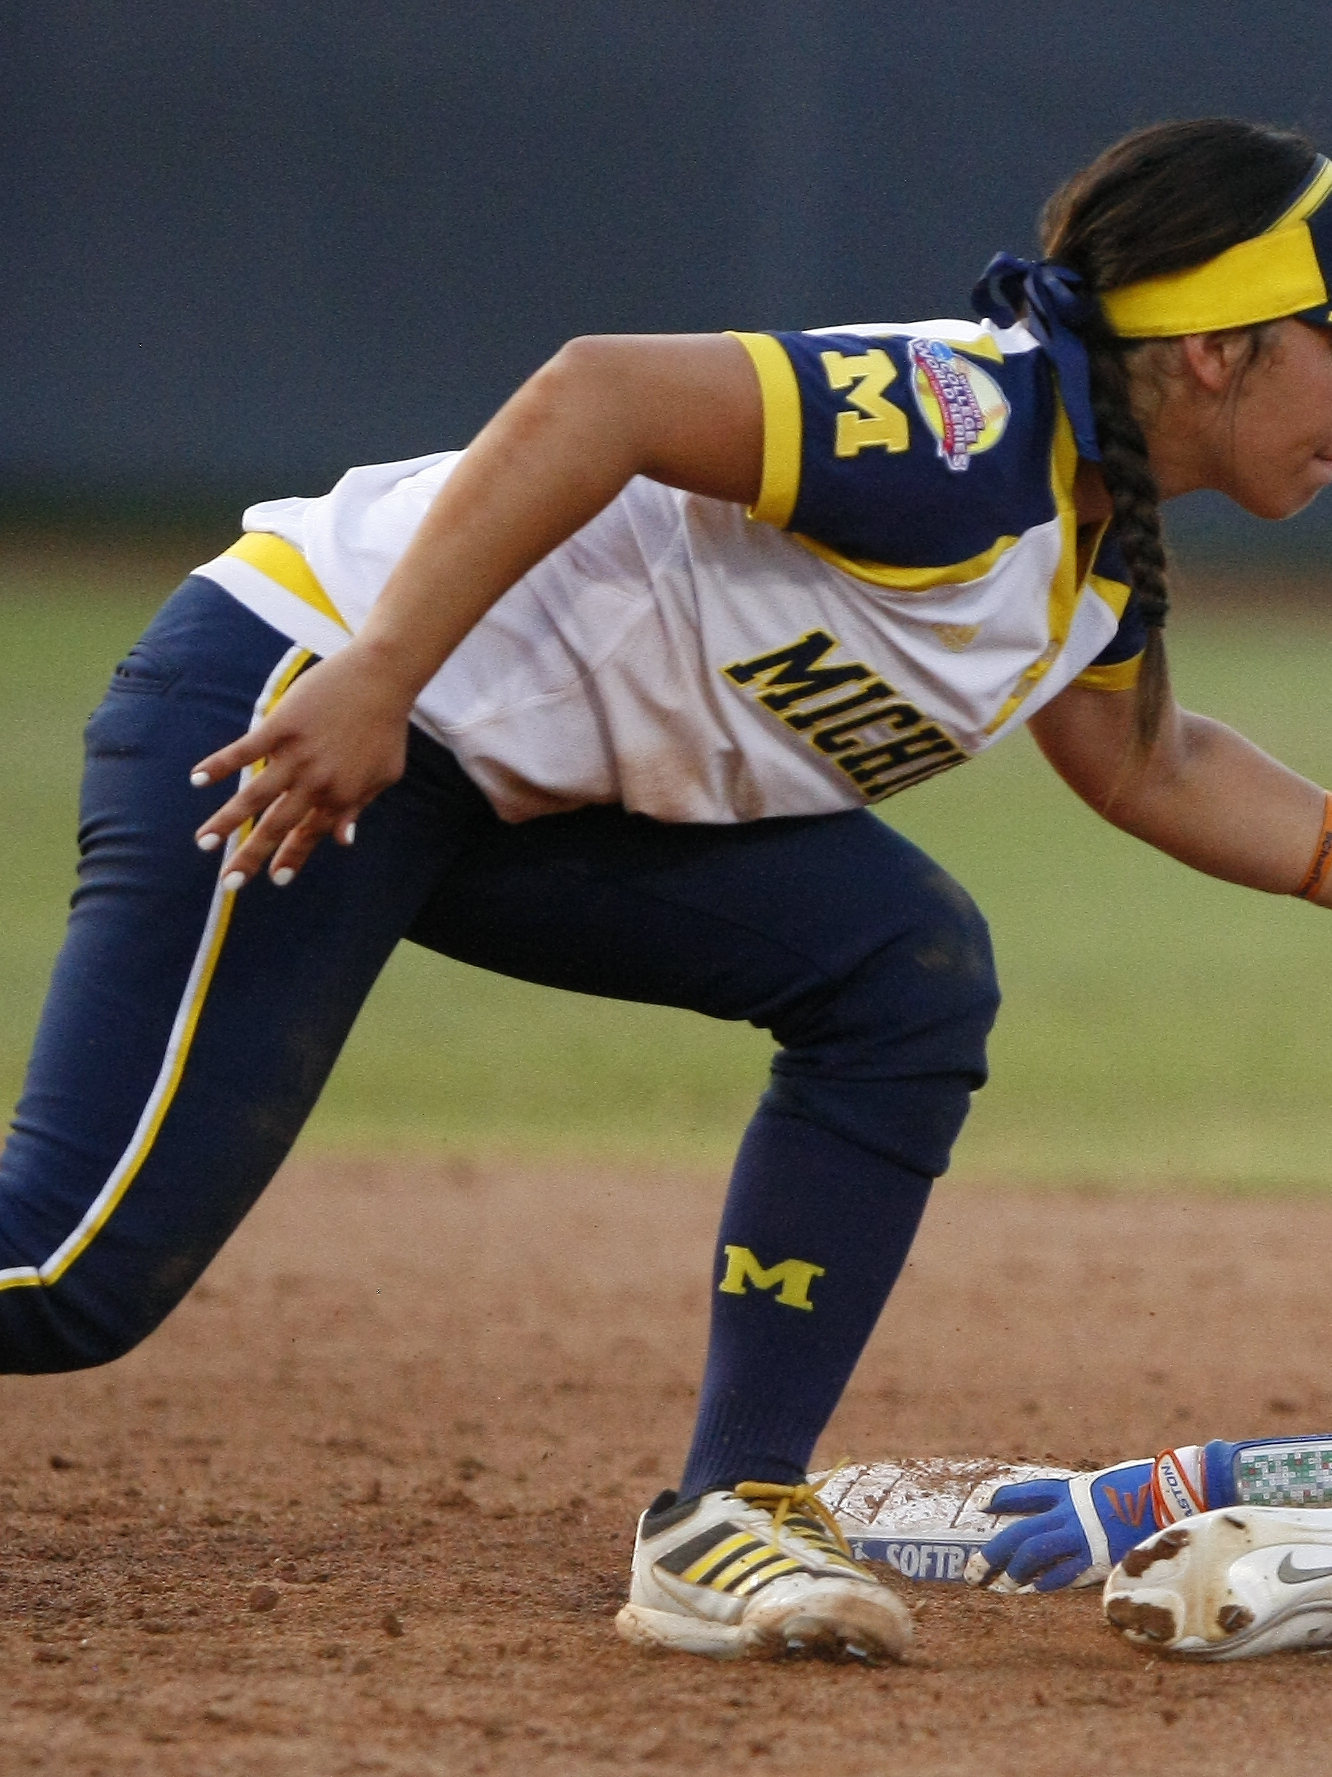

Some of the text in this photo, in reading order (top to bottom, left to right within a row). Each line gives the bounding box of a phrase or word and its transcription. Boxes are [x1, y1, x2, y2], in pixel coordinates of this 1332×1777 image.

[821, 349, 909, 457] M
[718, 1244, 827, 1312] M
[1161, 1464, 1193, 1518] ASTON
[886, 1543, 980, 1579] SOFTB
